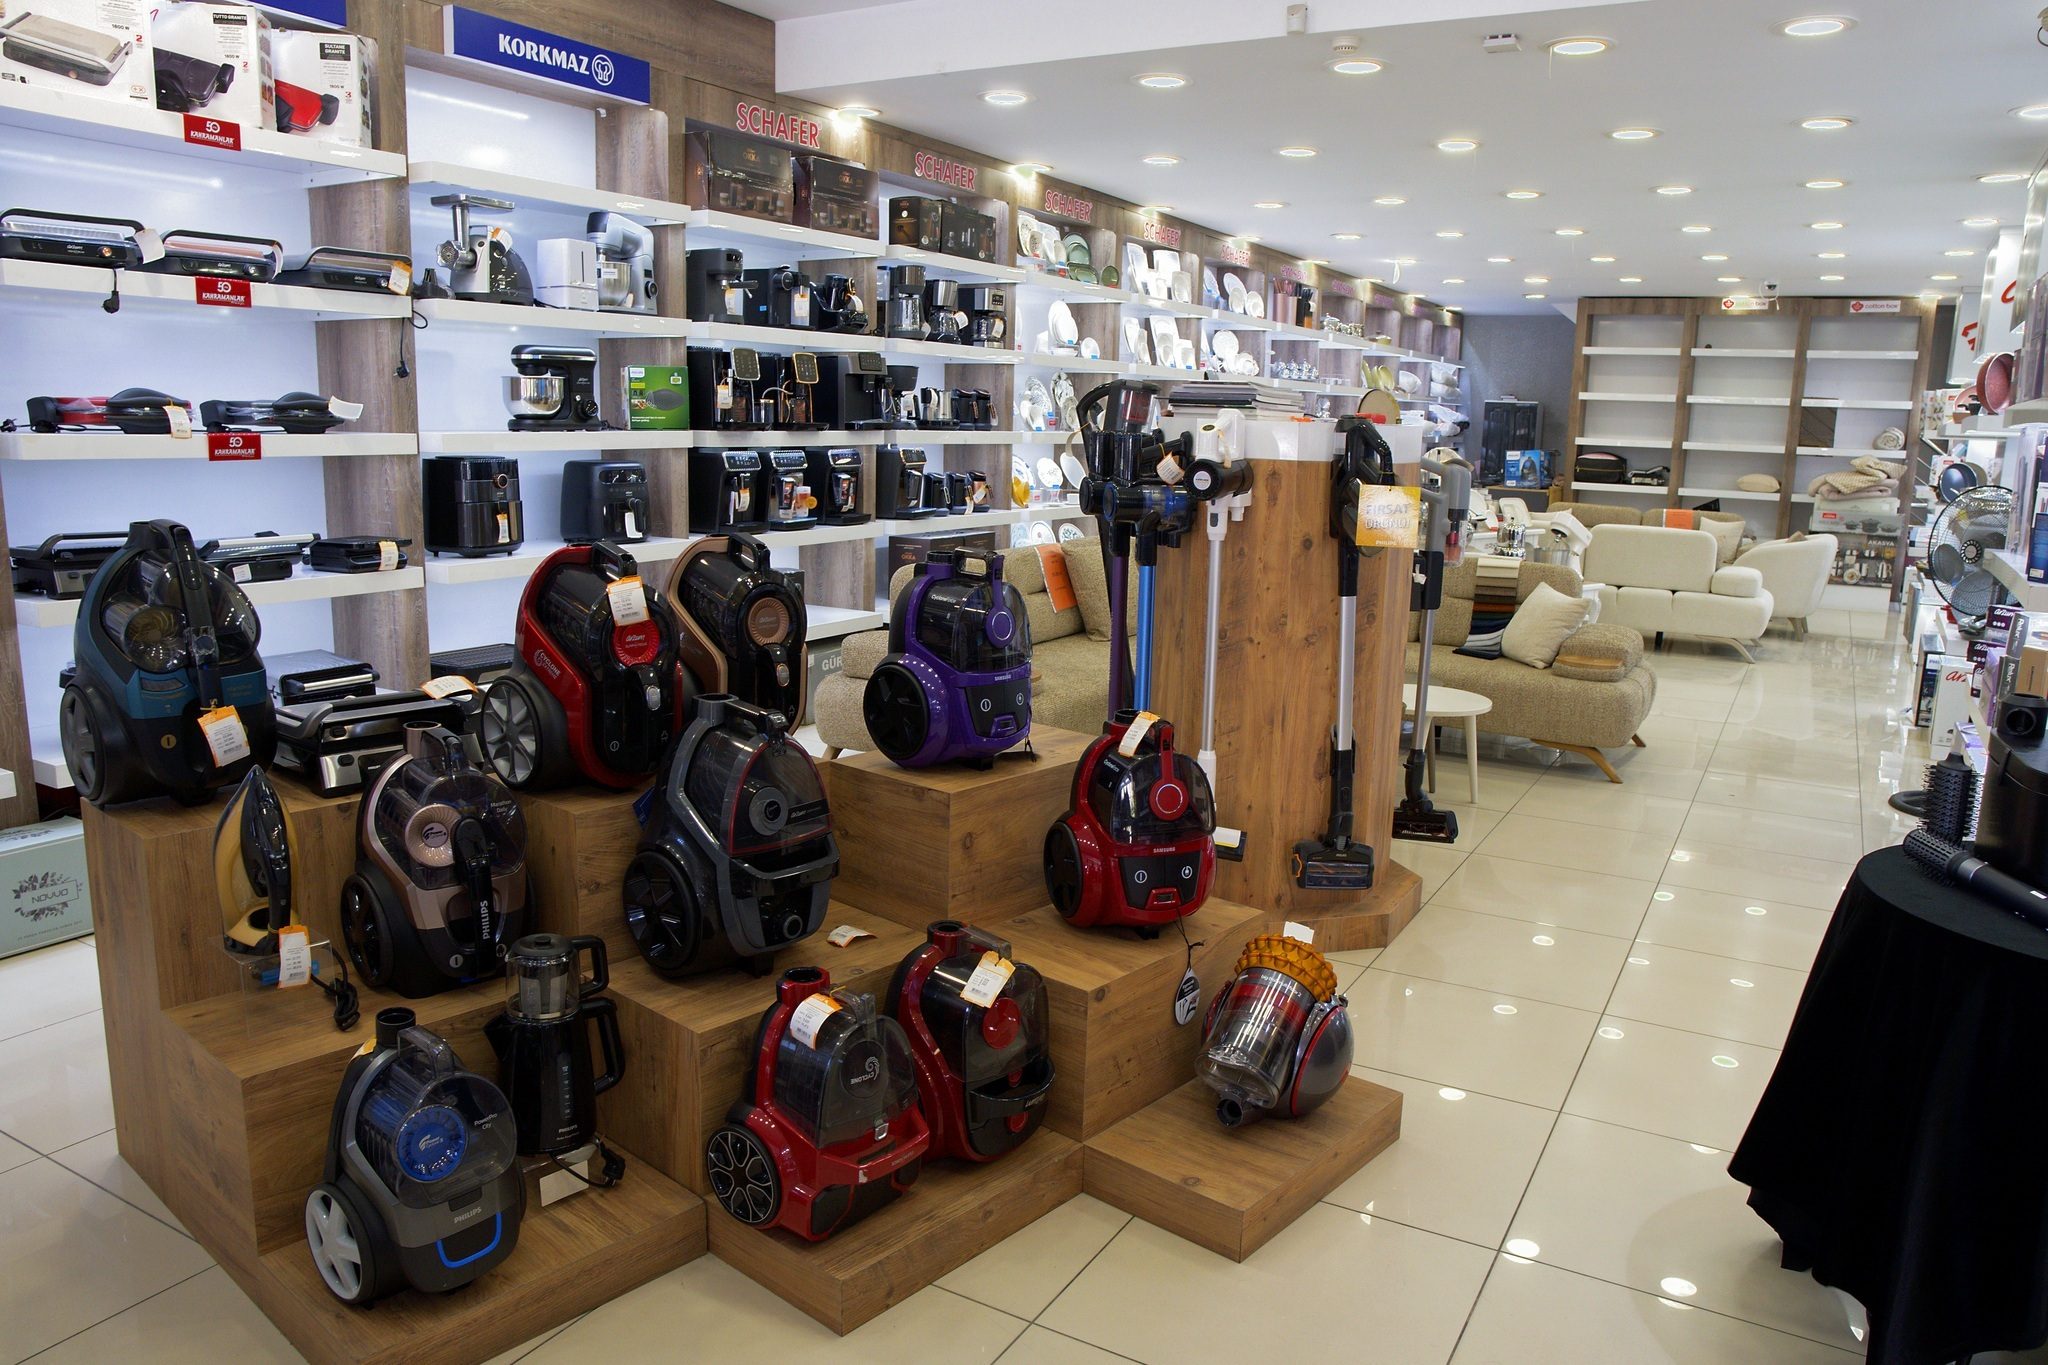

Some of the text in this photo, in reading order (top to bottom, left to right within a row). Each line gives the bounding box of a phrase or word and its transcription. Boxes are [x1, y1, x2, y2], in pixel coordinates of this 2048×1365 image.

[136, 34, 143, 42] 2
[498, 33, 590, 76] KORKMAZ
[736, 102, 820, 149] SCHAFER
[190, 130, 235, 144] KAHRAMANLAR
[915, 152, 976, 192] SCHAFER
[1045, 189, 1092, 224] SCHAFER
[1143, 221, 1181, 249] SCHAFER
[202, 292, 245, 303] KAHRAMANLAR
[214, 448, 256, 456] KAHRAMANLAR
[1366, 503, 1411, 515] FIRSAT
[821, 654, 842, 671] GÜR
[1153, 846, 1176, 854] SAMSUNG
[480, 900, 491, 940] PHILIPS
[474, 1112, 498, 1126] PowerPro
[482, 1122, 493, 1131] City
[454, 1206, 483, 1224] PHILIPS
